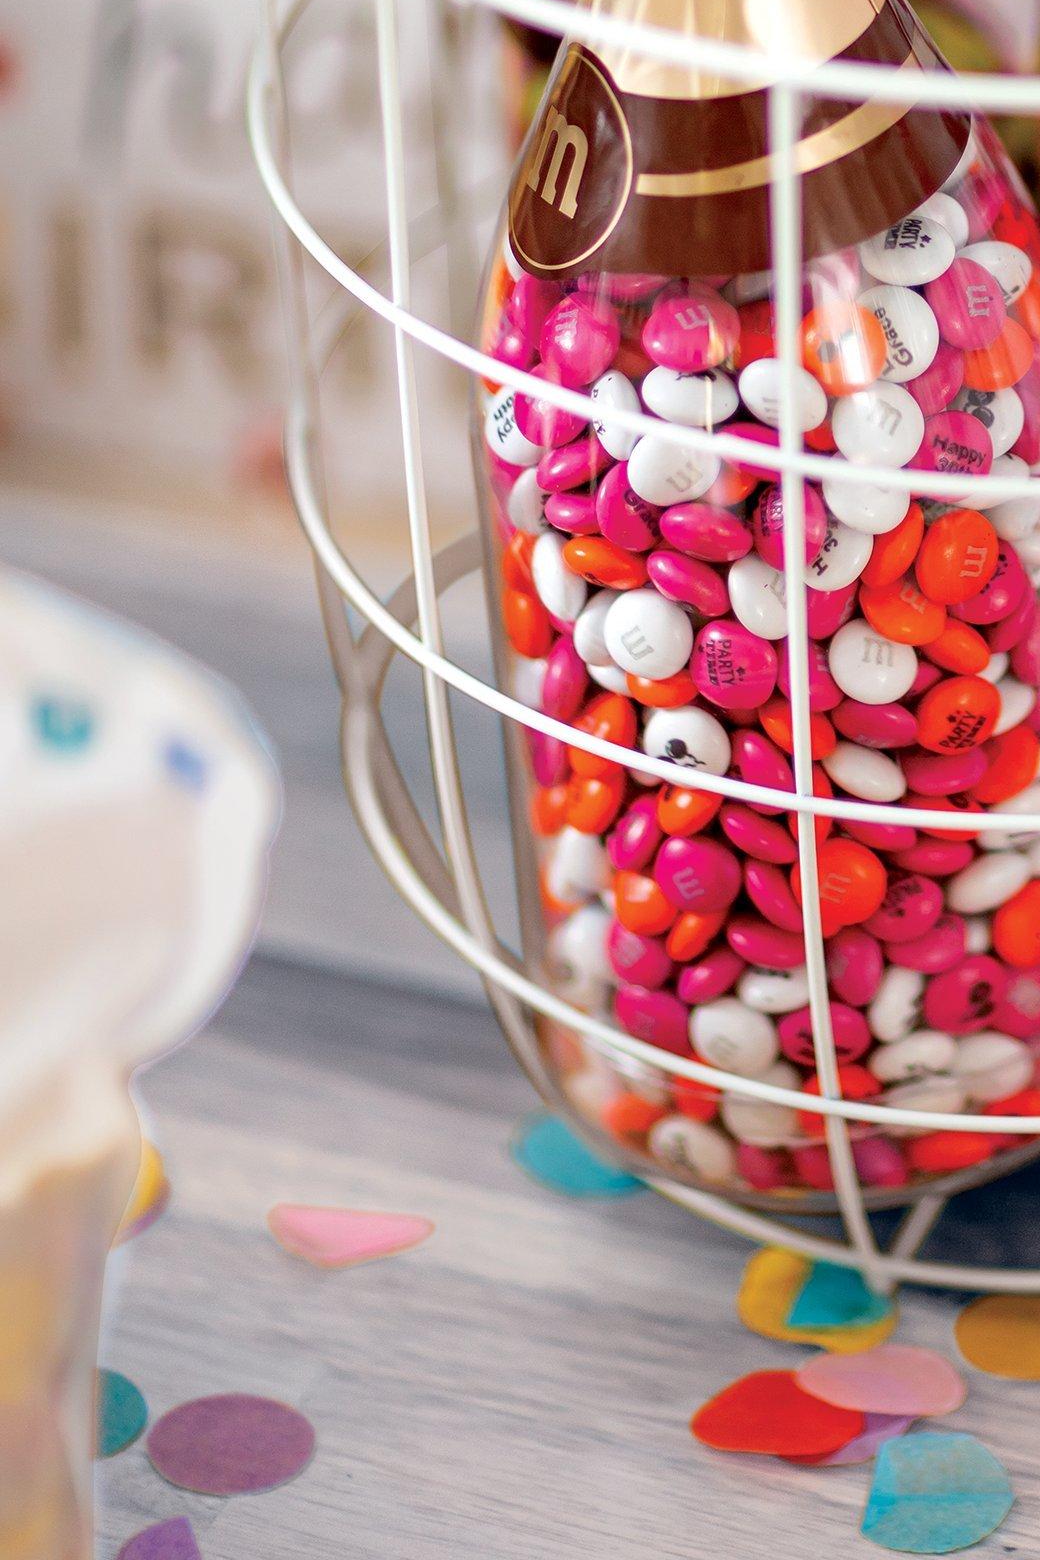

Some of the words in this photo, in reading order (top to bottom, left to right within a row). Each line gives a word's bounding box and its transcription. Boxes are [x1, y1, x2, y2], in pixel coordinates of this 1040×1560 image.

[526, 105, 589, 220] m
[898, 218, 922, 250] PARTY
[966, 285, 990, 318] m
[874, 307, 913, 367] Grace
[493, 396, 514, 421] 0th
[932, 434, 987, 468] Happy
[960, 546, 988, 578] m
[718, 639, 735, 686] PARTY
[862, 636, 895, 668] m
[938, 710, 976, 748] PARTY
[672, 866, 705, 900] m
